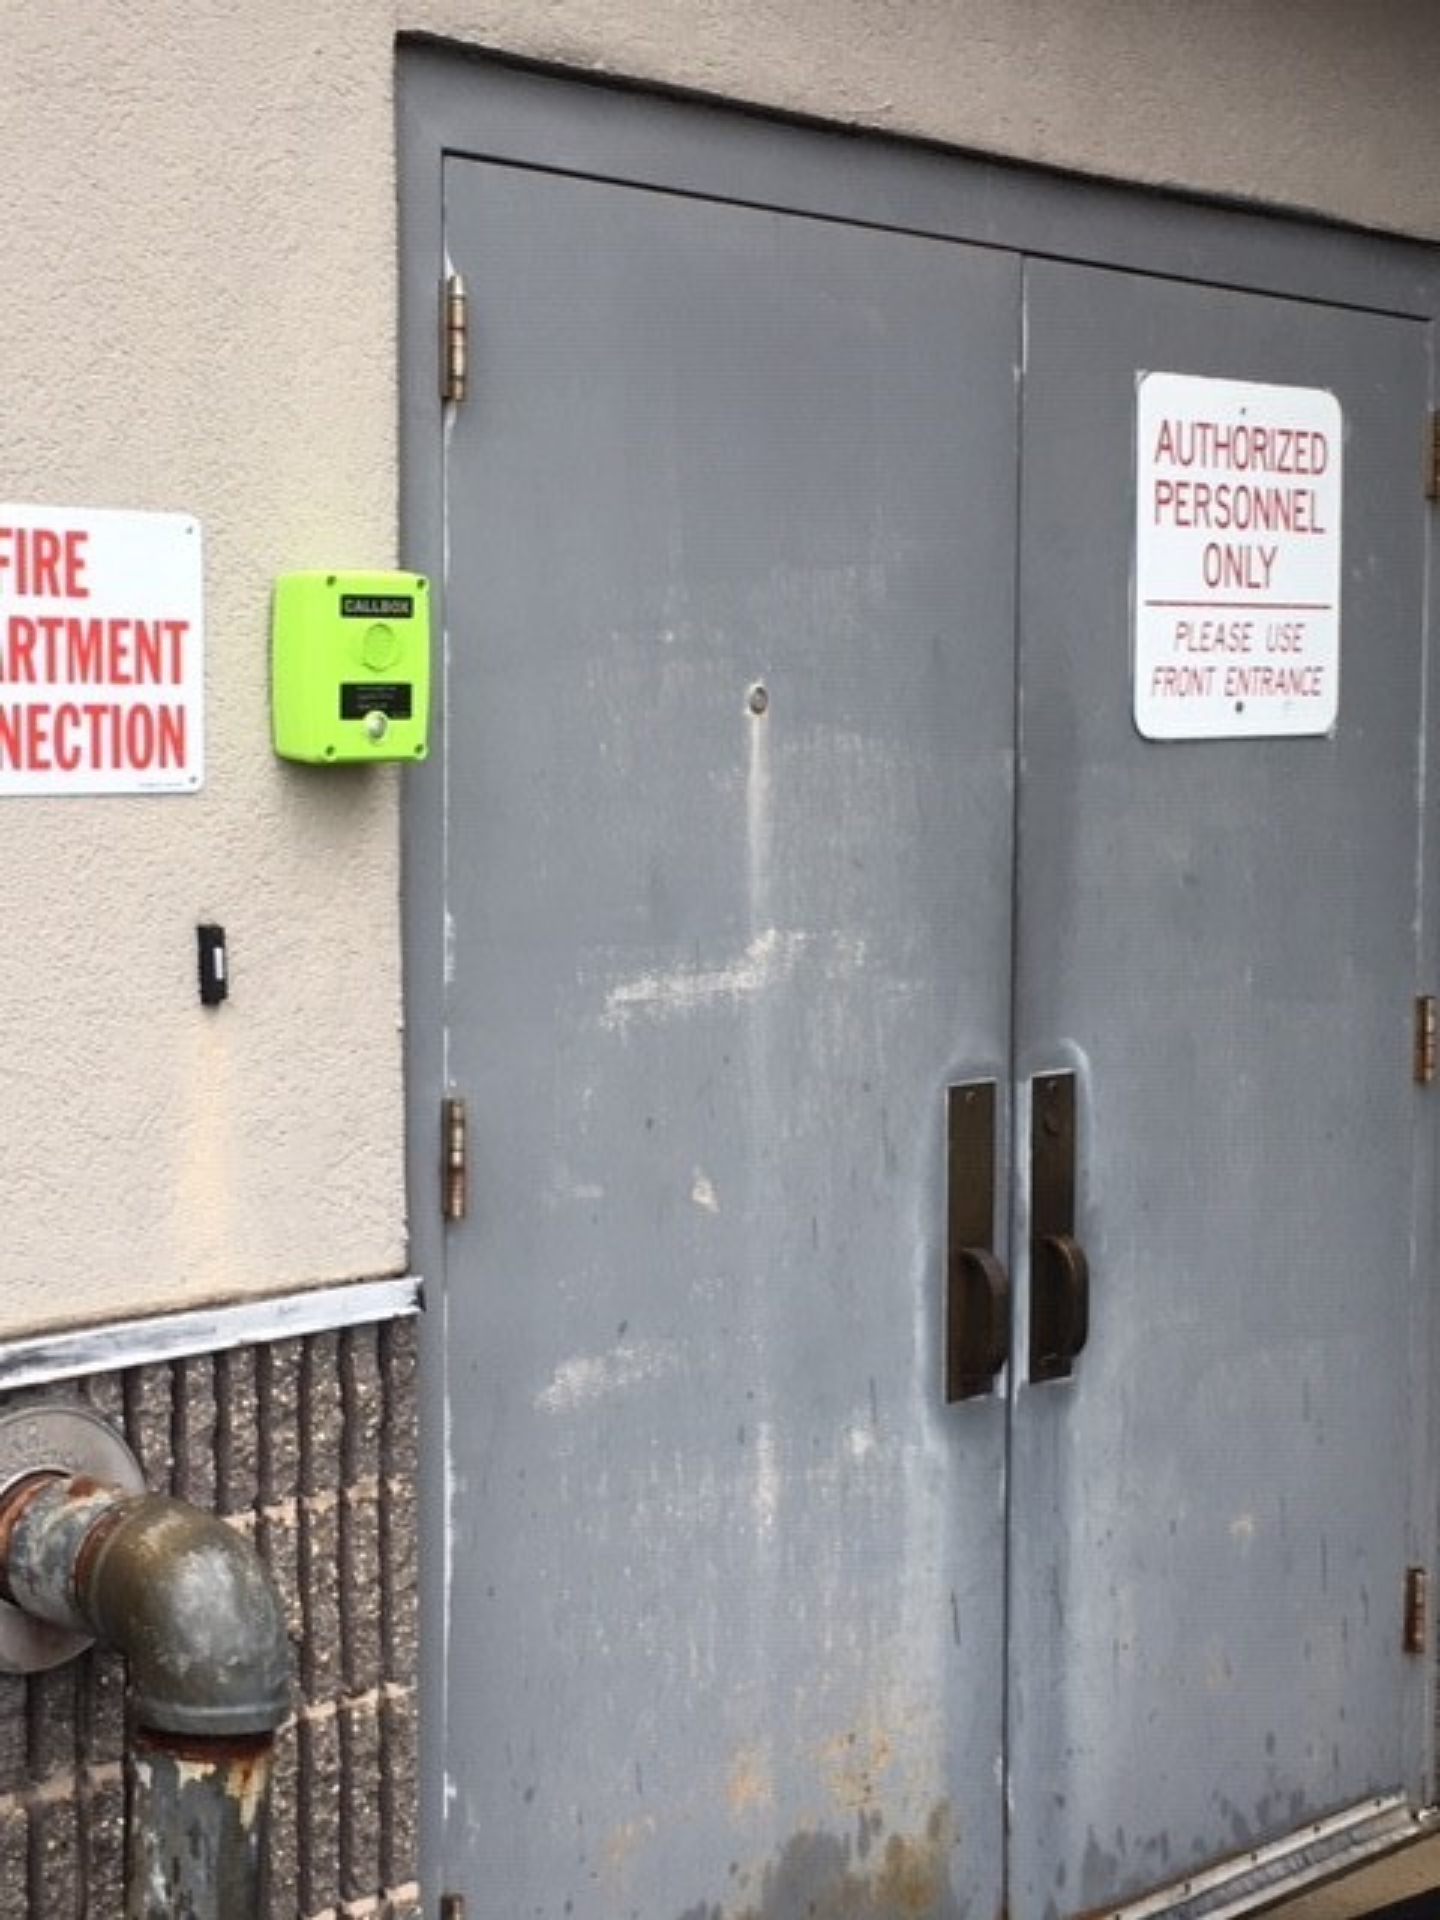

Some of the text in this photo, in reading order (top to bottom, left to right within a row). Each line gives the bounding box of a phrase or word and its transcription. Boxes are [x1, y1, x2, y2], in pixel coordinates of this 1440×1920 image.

[1154, 419, 1328, 476] AUTHORIZED
[1154, 480, 1326, 535] PERSONNEL
[1202, 542, 1277, 589] ONLY
[344, 598, 410, 614] CALLBOX
[0, 615, 190, 685] RTMENT
[1173, 620, 1306, 653] PLEASE USE
[1151, 666, 1325, 697] FRONT ENTRANCE
[0, 701, 187, 771] NECTION
